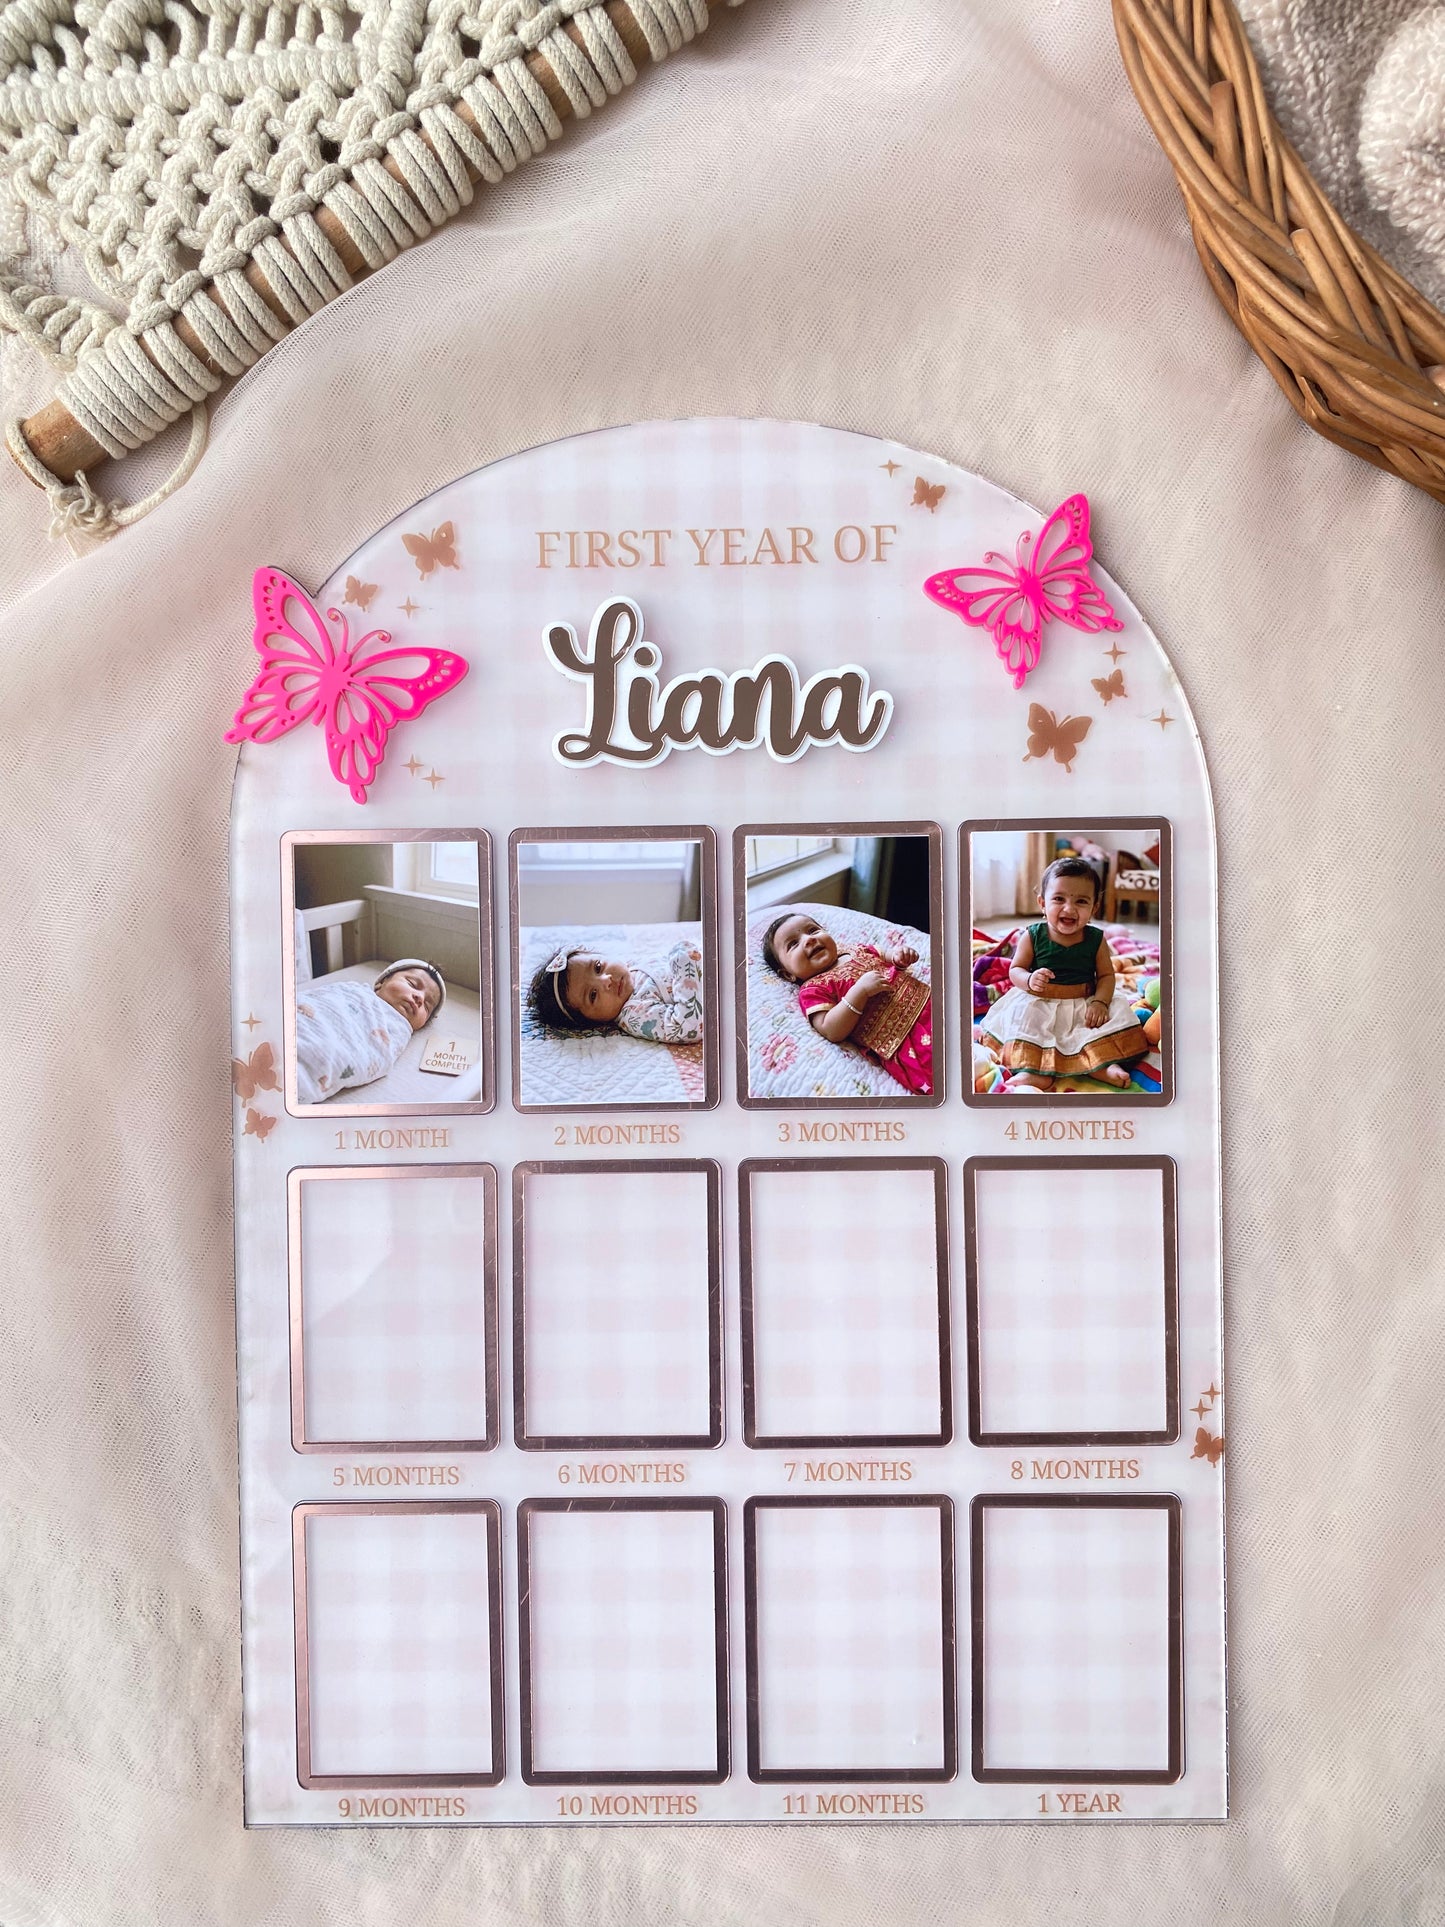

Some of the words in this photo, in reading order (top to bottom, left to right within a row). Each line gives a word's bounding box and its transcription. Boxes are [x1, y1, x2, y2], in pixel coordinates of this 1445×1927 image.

[536, 529, 672, 568] FIRST
[685, 527, 818, 566] YEAR
[834, 525, 897, 563] OF
[548, 602, 885, 760] Liana
[433, 1052, 467, 1062] MONTH
[449, 1041, 456, 1053] 1
[335, 1130, 347, 1150] 1
[354, 1128, 449, 1150] MONTH
[554, 1126, 567, 1145] 2
[574, 1124, 681, 1145] MONTHS
[778, 1122, 791, 1142] 3
[798, 1122, 906, 1142] MONTHS
[1004, 1121, 1019, 1140] 4
[1024, 1120, 1135, 1140] MONTHS
[332, 1467, 345, 1487] 5
[353, 1466, 460, 1486] MONTHS
[558, 1464, 571, 1484] 6
[577, 1463, 685, 1484] MONTHS
[784, 1462, 796, 1482] 7
[804, 1461, 912, 1481] MONTHS
[1010, 1461, 1024, 1480] 8
[1030, 1459, 1140, 1480] MONTHS
[338, 1798, 350, 1817] 9
[358, 1797, 466, 1817] MONTHS
[556, 1796, 582, 1816] 10
[590, 1795, 698, 1815] MONTHS
[783, 1795, 808, 1814] 11
[816, 1794, 924, 1814] MONTHS
[1037, 1793, 1049, 1813] 1
[1056, 1793, 1122, 1813] YEAR
